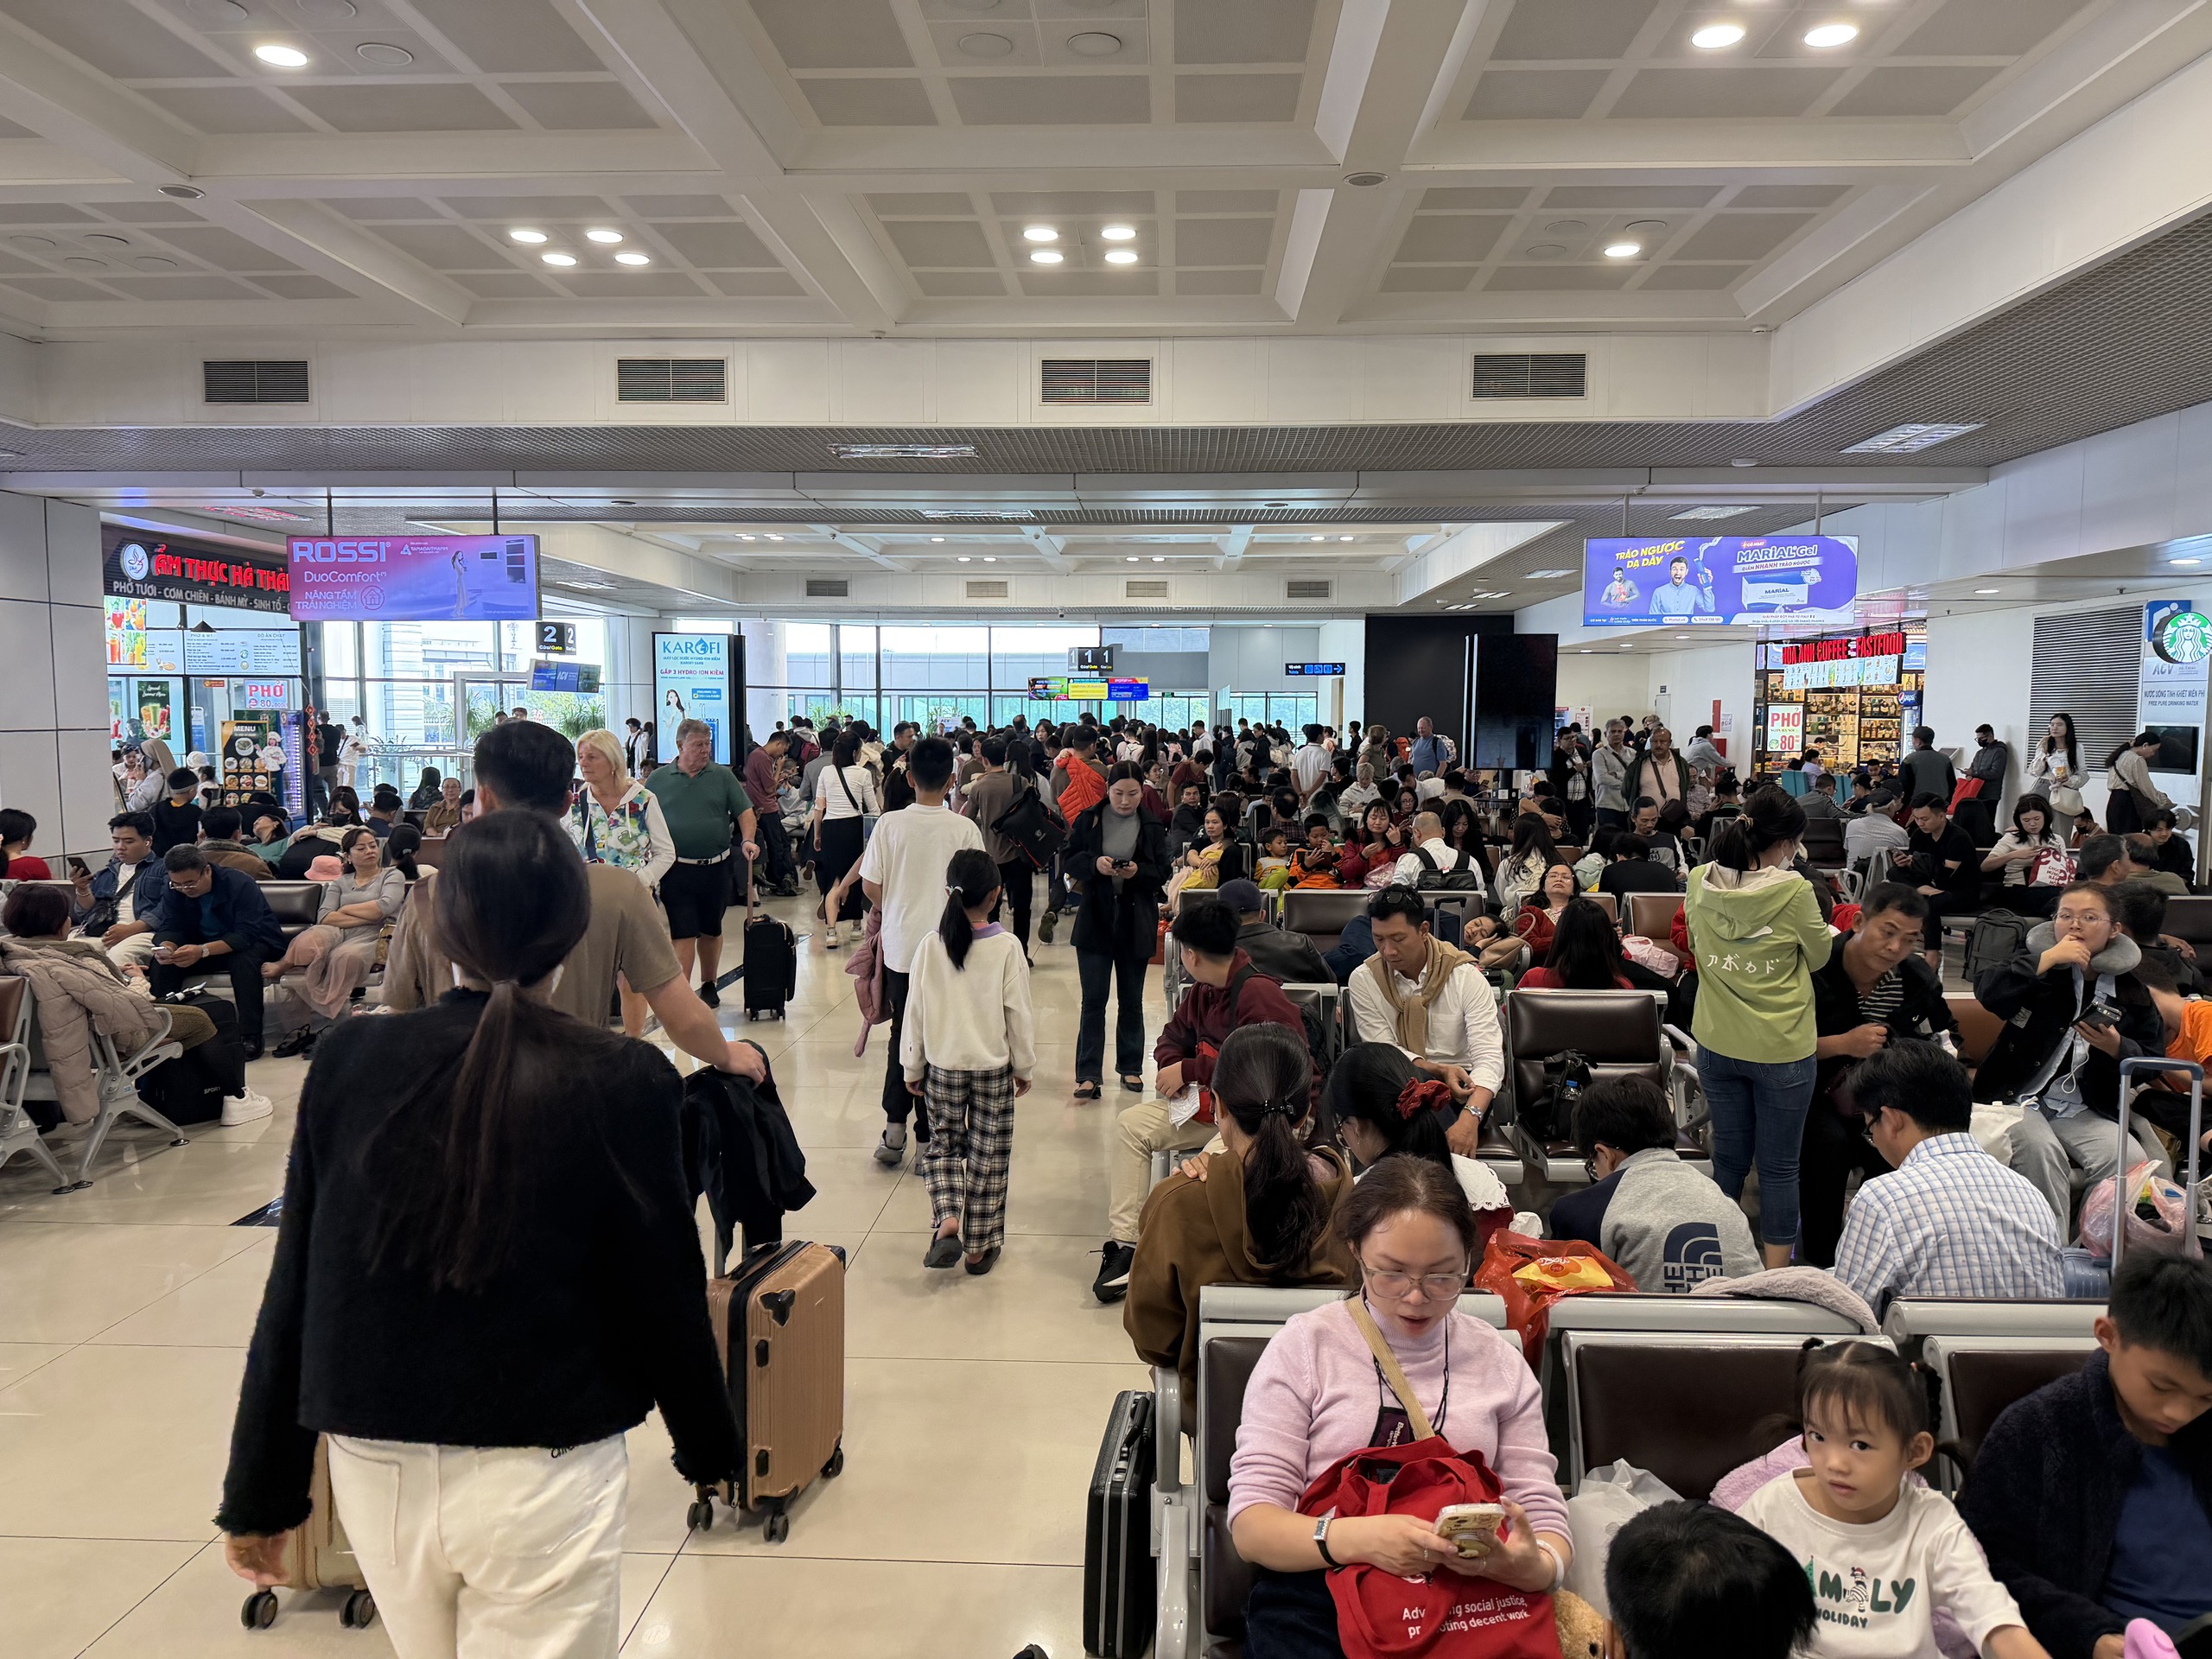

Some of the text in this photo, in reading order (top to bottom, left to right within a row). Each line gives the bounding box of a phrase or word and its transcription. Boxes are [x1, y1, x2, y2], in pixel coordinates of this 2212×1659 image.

[1616, 540, 1686, 561] TRÀO NGƯỢC
[154, 544, 289, 592] ẨM THỰC HÀ THÀ
[1627, 560, 1640, 569] DẠ
[1755, 562, 1778, 570] NHANH
[113, 579, 282, 611] PHỞ TƯƠI CƠM CHIÊN BÁNH MỲ SINH TỐ
[543, 626, 556, 643] 2
[567, 627, 575, 644] 2
[1816, 639, 1848, 661] COFFEE
[1856, 632, 1904, 658] FASTFOOD
[1084, 650, 1091, 663] 1
[1103, 650, 1109, 663] 1
[248, 681, 284, 697] PHỞ
[1770, 707, 1802, 728] PHỞ
[1780, 734, 1795, 750] 80
[1465, 1598, 1494, 1614] social
[1495, 1594, 1529, 1611] justice,
[1469, 1611, 1508, 1628] decent
